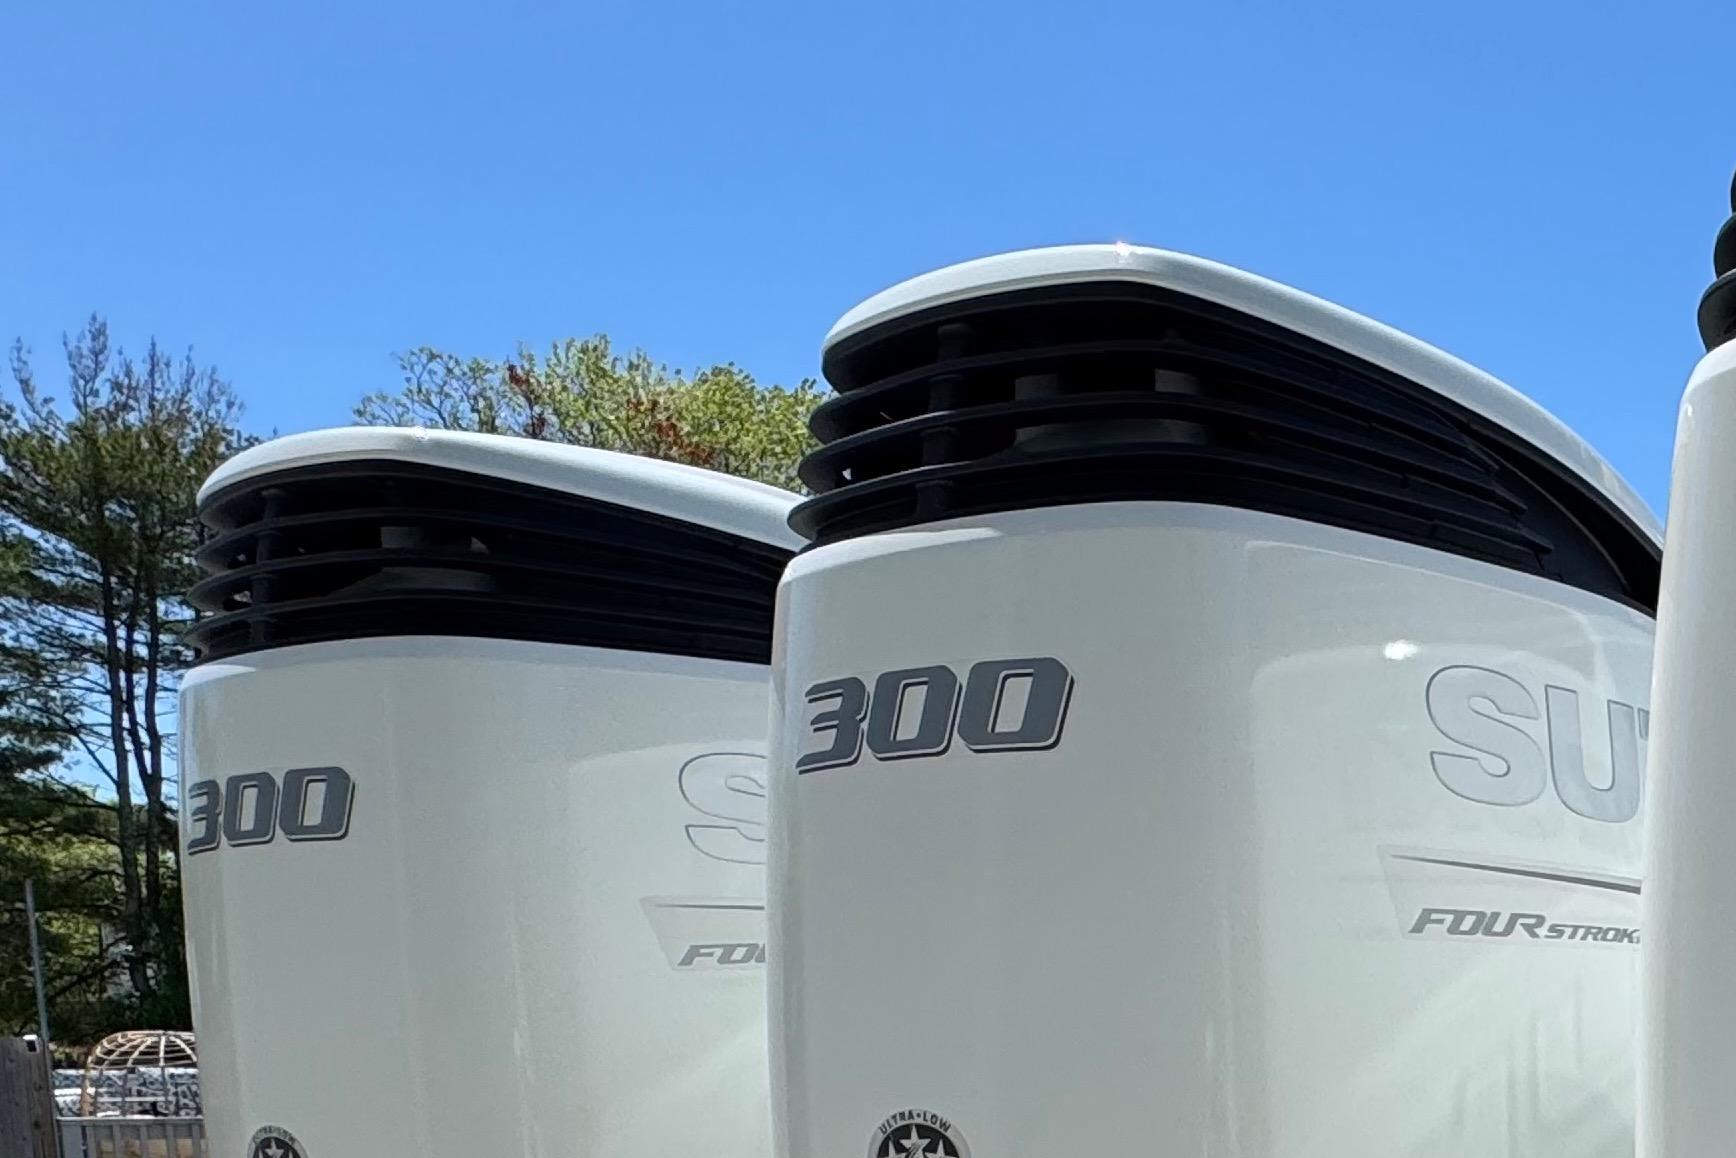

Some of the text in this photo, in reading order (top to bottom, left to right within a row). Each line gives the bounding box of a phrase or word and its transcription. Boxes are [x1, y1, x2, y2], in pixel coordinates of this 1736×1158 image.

[796, 657, 1075, 775] 300
[1426, 664, 1650, 823] SU
[187, 766, 355, 856] 300
[1408, 908, 1641, 943] FOUR STROK
[878, 1110, 951, 1135] ULTRA LOW
